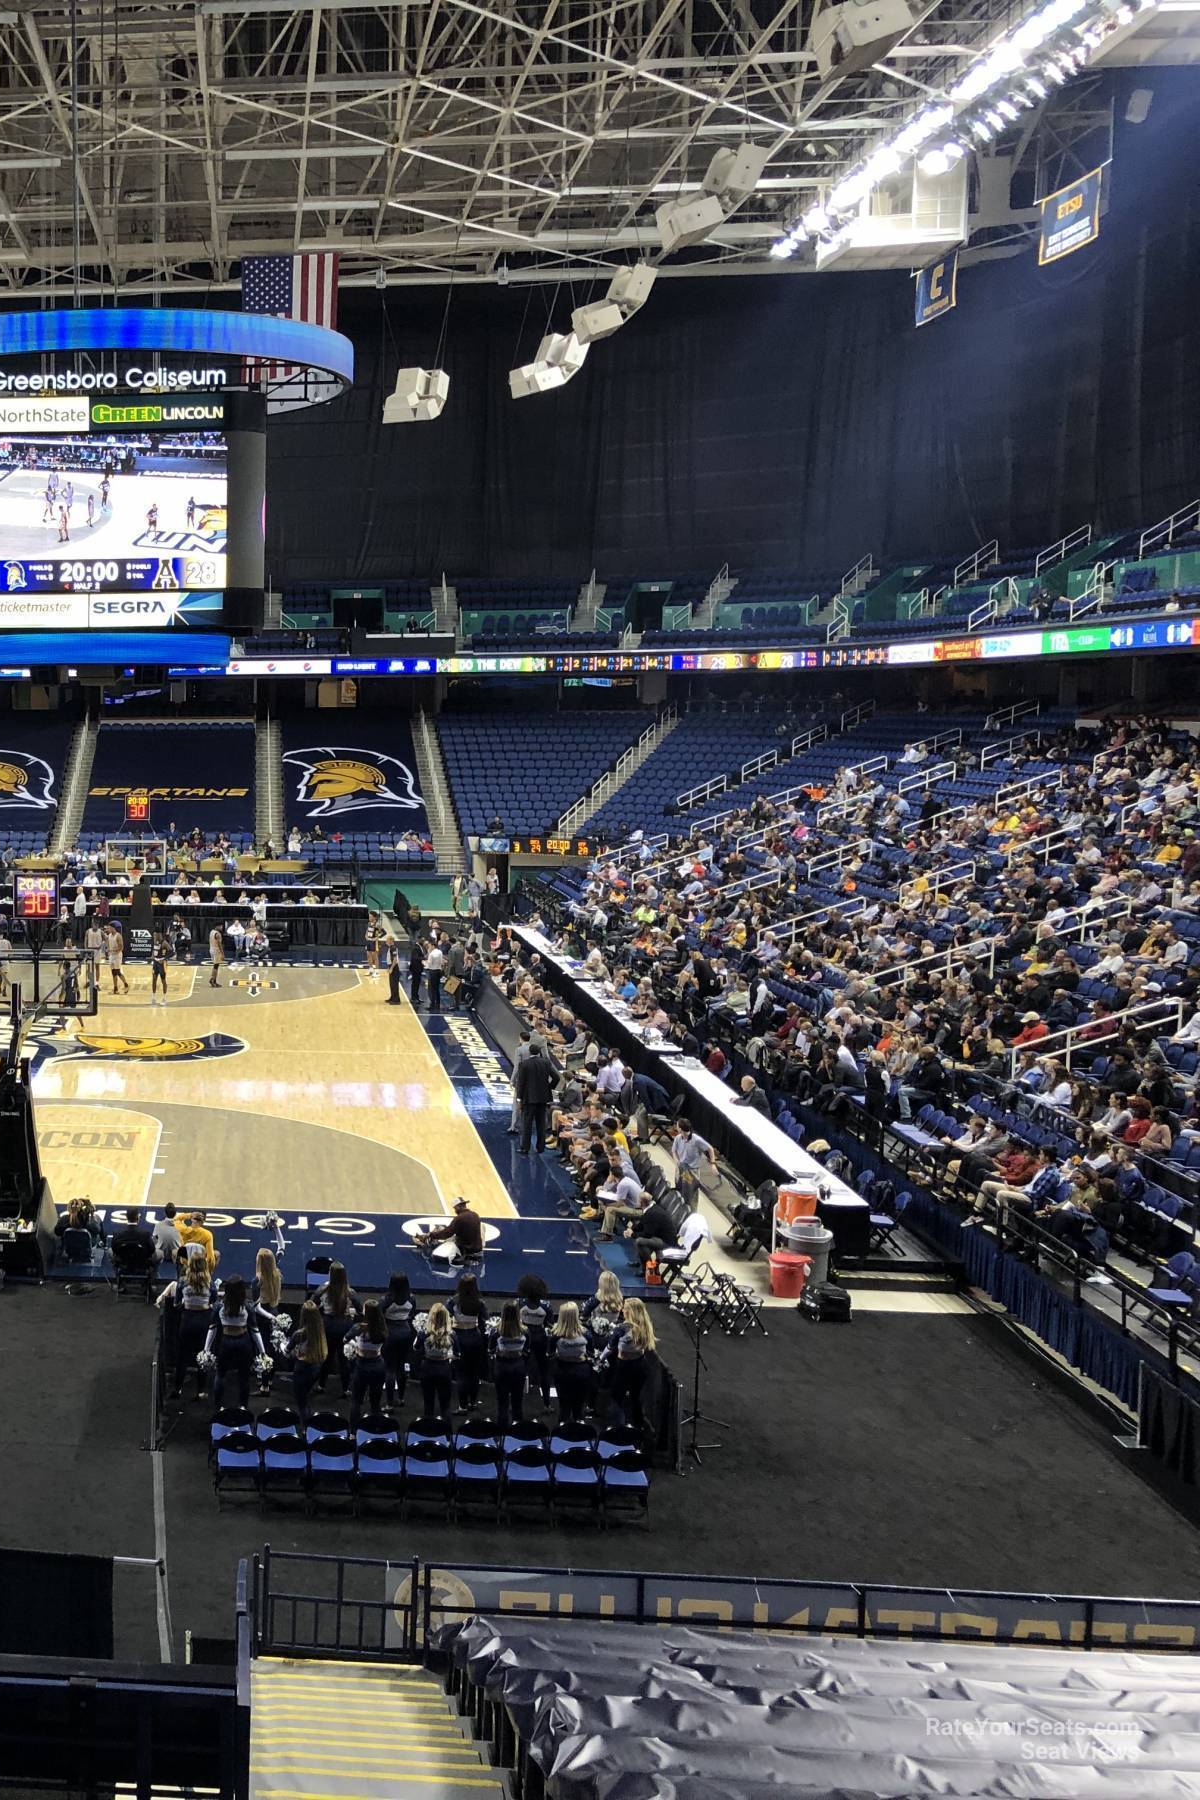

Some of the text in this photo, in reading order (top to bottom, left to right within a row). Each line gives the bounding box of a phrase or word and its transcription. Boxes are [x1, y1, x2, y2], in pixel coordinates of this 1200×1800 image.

[931, 263, 944, 299] C
[126, 368, 227, 388] Coliseum
[92, 405, 224, 423] GREEN LINCOLN
[60, 562, 119, 582] 20:00
[186, 561, 217, 585] 28
[73, 582, 92, 590] HALF
[0, 602, 71, 614] ticketmaster
[93, 601, 166, 614] SEGRA
[459, 658, 522, 671] DO THE DEW
[573, 660, 579, 668] 2
[598, 659, 607, 667] 14
[623, 659, 632, 667] 21
[711, 657, 725, 669] 29
[780, 655, 793, 667] 28
[89, 787, 249, 797] SPARTANS
[127, 797, 148, 805] 20:00
[130, 805, 146, 817] 30
[531, 844, 541, 853] 29
[546, 840, 570, 850] 20:00
[18, 877, 54, 890] 20:00
[24, 891, 49, 914] 30
[130, 929, 152, 938] TFA
